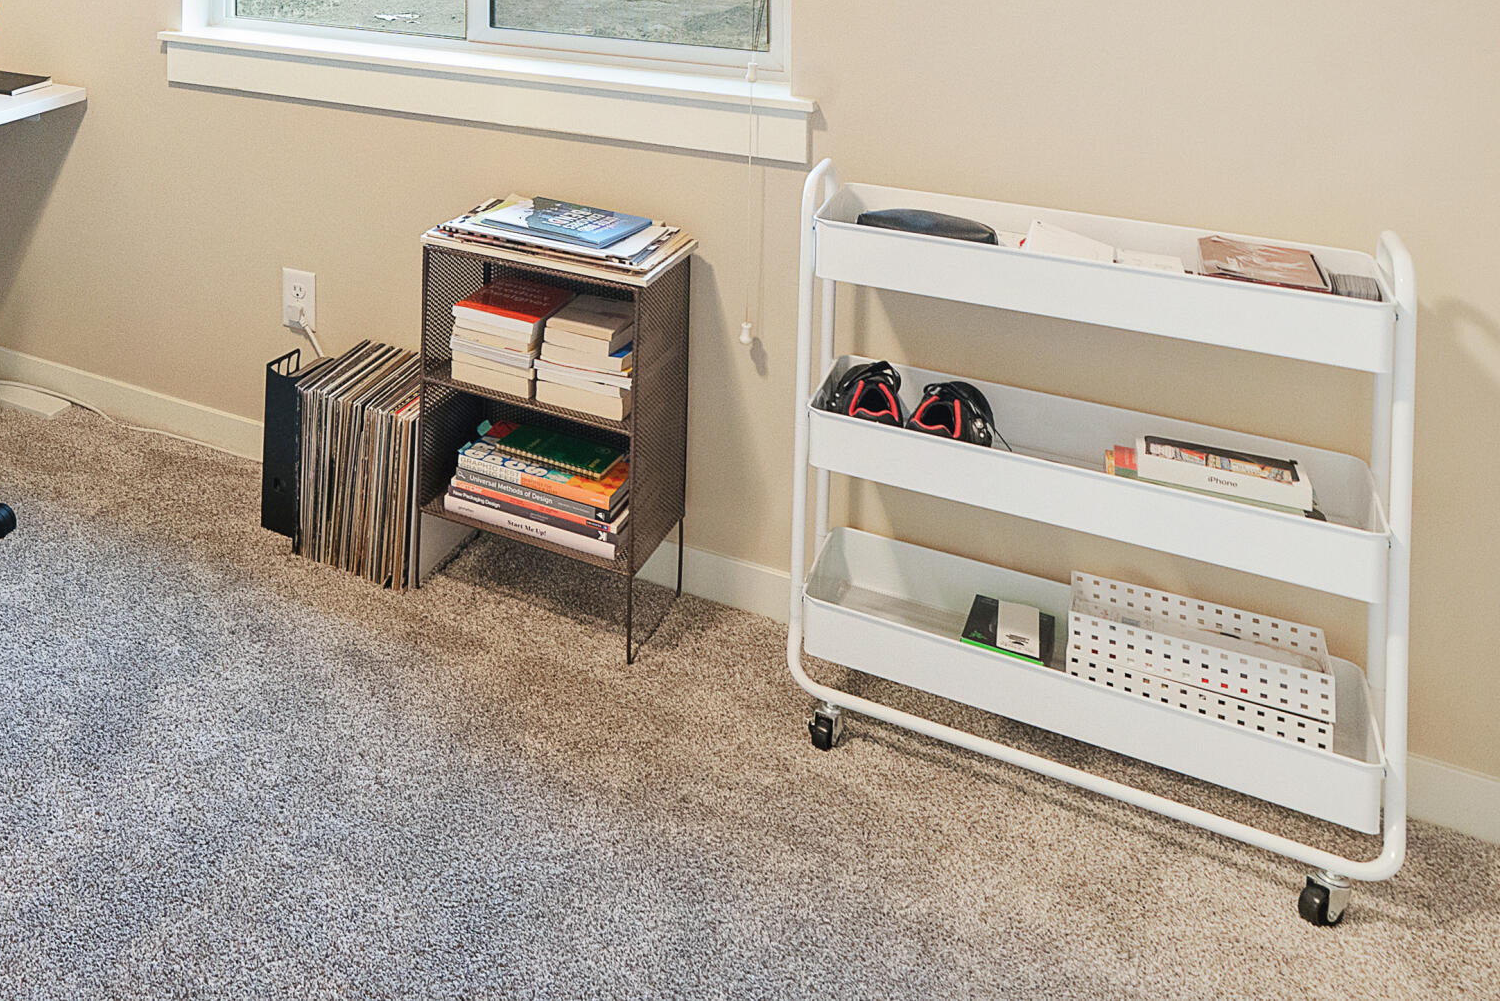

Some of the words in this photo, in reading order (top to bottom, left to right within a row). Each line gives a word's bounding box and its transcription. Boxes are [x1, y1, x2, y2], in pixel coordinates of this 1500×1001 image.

[469, 475, 497, 488] Universal
[498, 482, 523, 495] Methods
[531, 492, 553, 504] Design
[1208, 476, 1238, 487] iPhone
[463, 492, 484, 504] Packaging
[484, 499, 500, 508] Design
[508, 520, 523, 529] Start
[525, 524, 535, 532] Me
[535, 527, 547, 536] Up!
